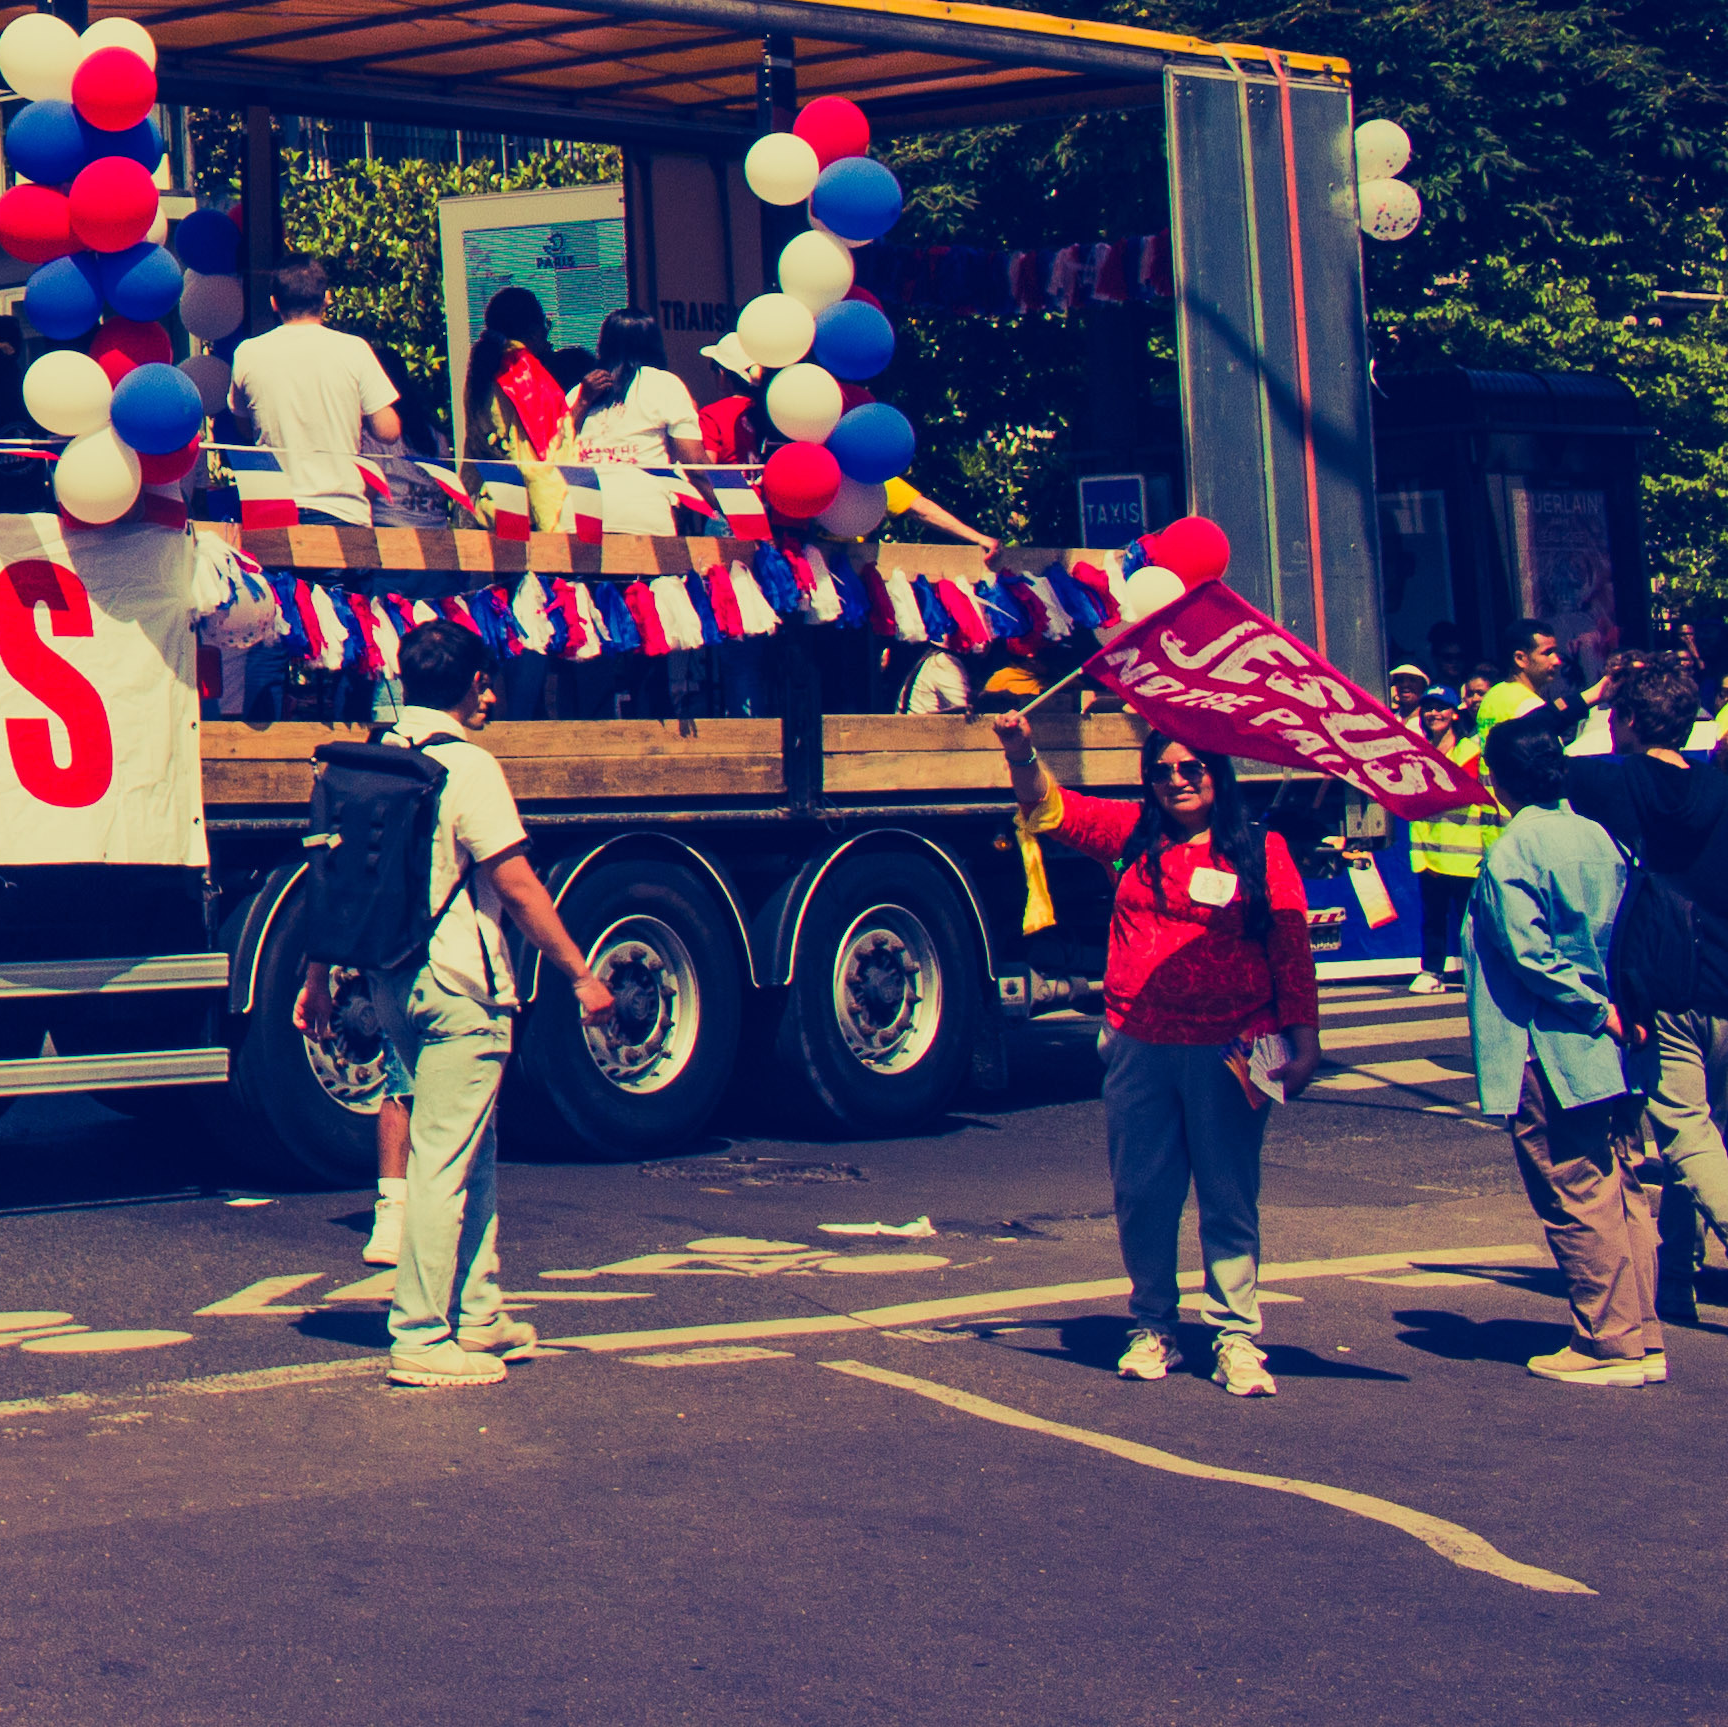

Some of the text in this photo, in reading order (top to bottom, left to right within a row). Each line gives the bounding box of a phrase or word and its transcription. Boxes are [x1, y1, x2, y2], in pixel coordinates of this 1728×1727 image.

[660, 300, 736, 332] TRANS
[1086, 502, 1140, 524] TAXIS
[1103, 646, 1265, 714] NOTRE
[1159, 620, 1458, 796] JESUS
